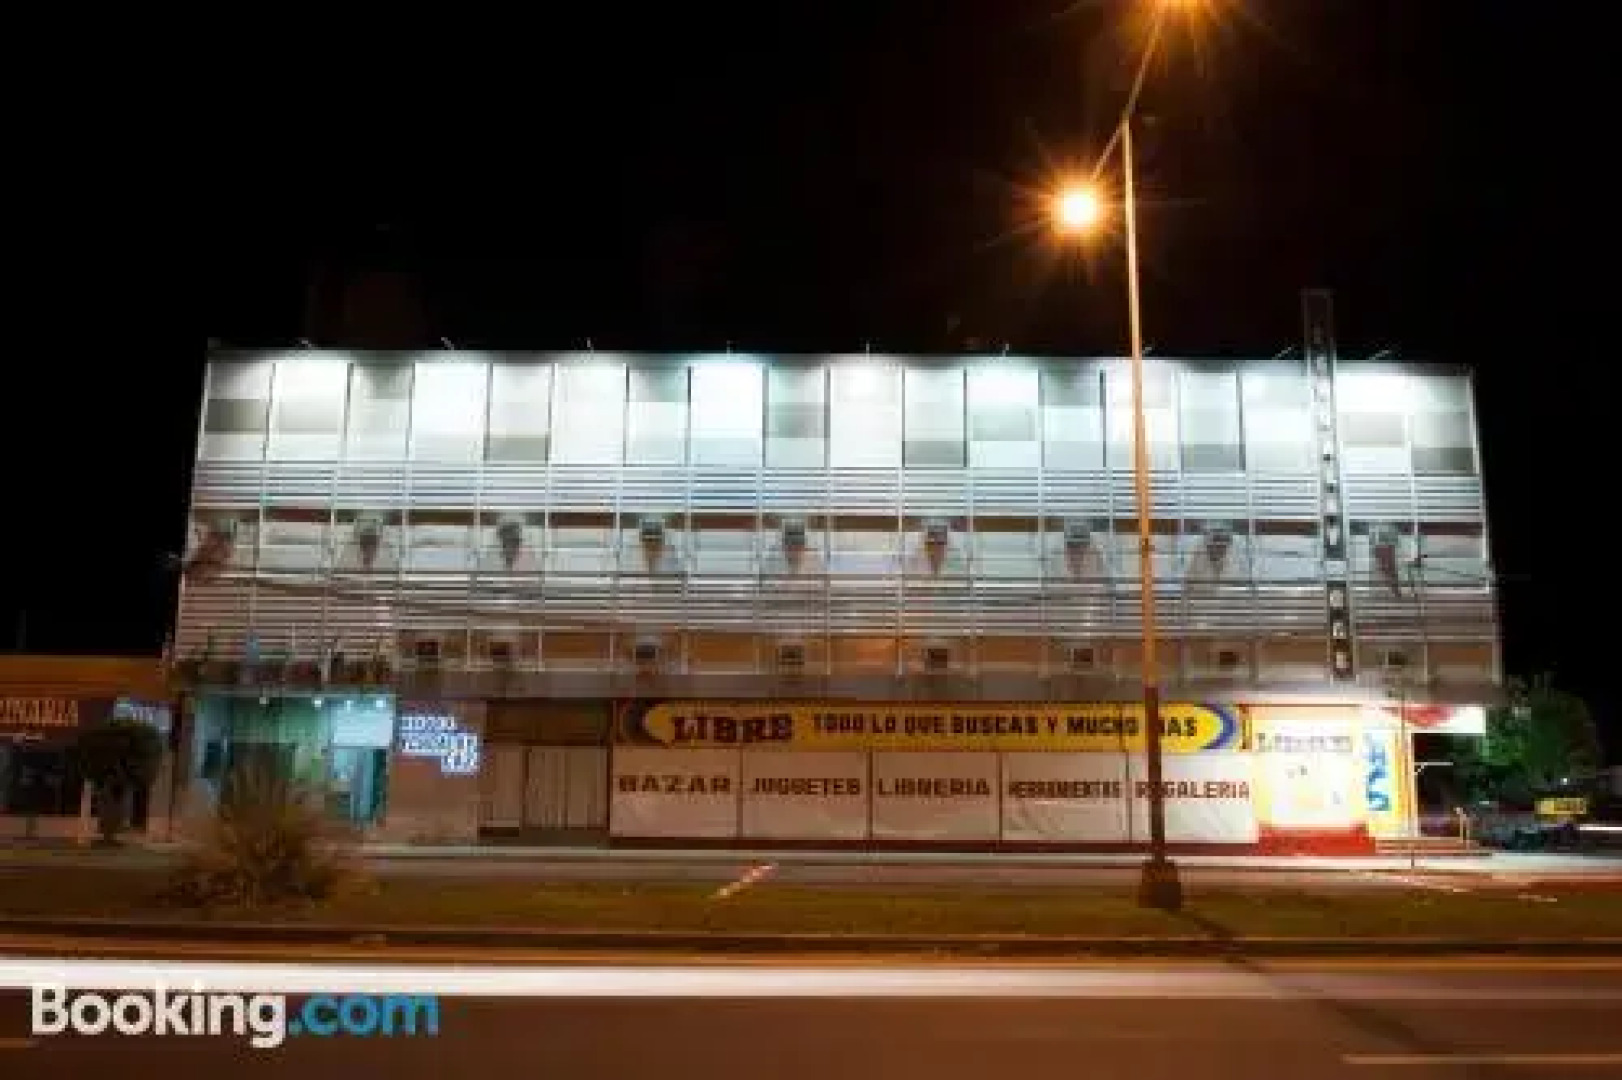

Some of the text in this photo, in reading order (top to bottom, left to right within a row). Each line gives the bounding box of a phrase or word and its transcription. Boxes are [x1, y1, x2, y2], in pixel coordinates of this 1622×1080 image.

[872, 713, 896, 734] LO
[904, 713, 945, 736] QUE
[952, 715, 1038, 735] BUSCAS
[1047, 715, 1058, 735] Y
[1066, 715, 1139, 736] MUCHO
[618, 774, 731, 794] BAZAR
[1134, 780, 1250, 799] RGALERIA
